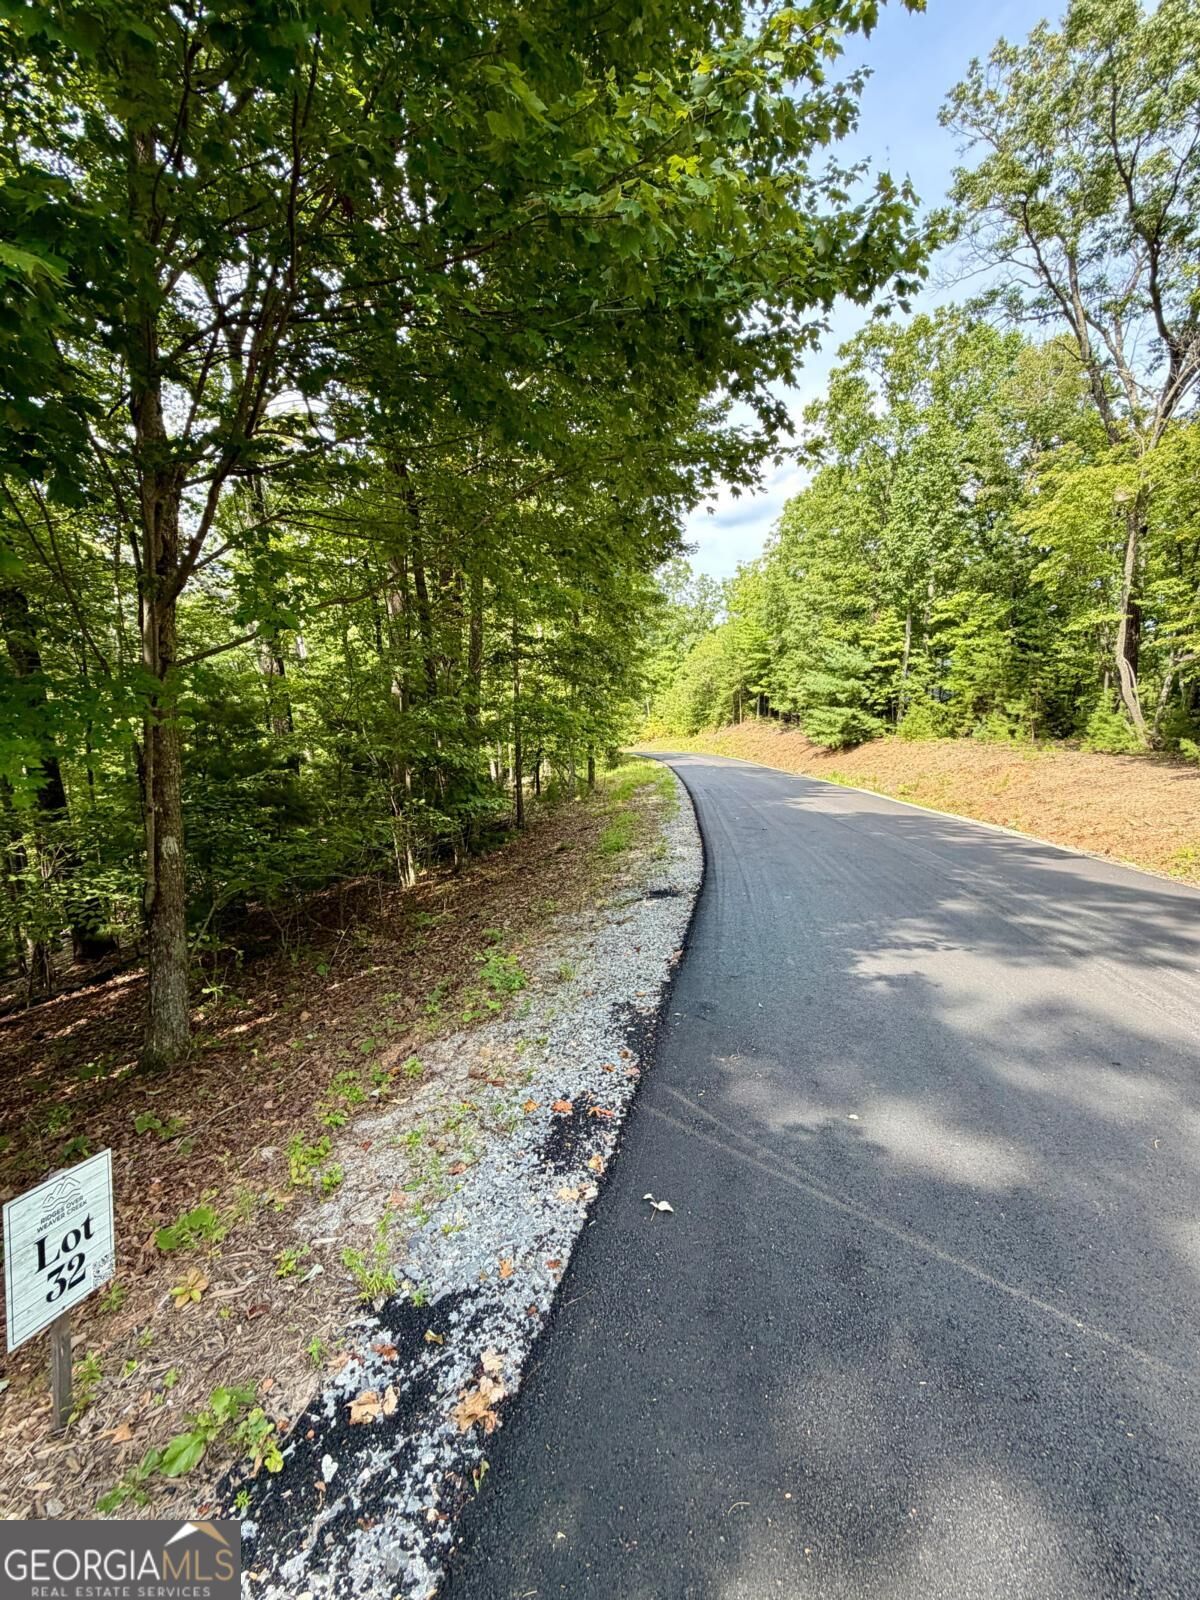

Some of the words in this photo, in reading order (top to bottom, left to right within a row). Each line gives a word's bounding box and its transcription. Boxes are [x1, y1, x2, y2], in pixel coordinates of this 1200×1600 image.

[36, 1213, 66, 1233] WEAVER
[66, 1200, 87, 1215] CREEK
[40, 1206, 65, 1224] RIDGES
[65, 1195, 84, 1209] OVER
[34, 1213, 95, 1275] Lot
[46, 1253, 86, 1303] 32
